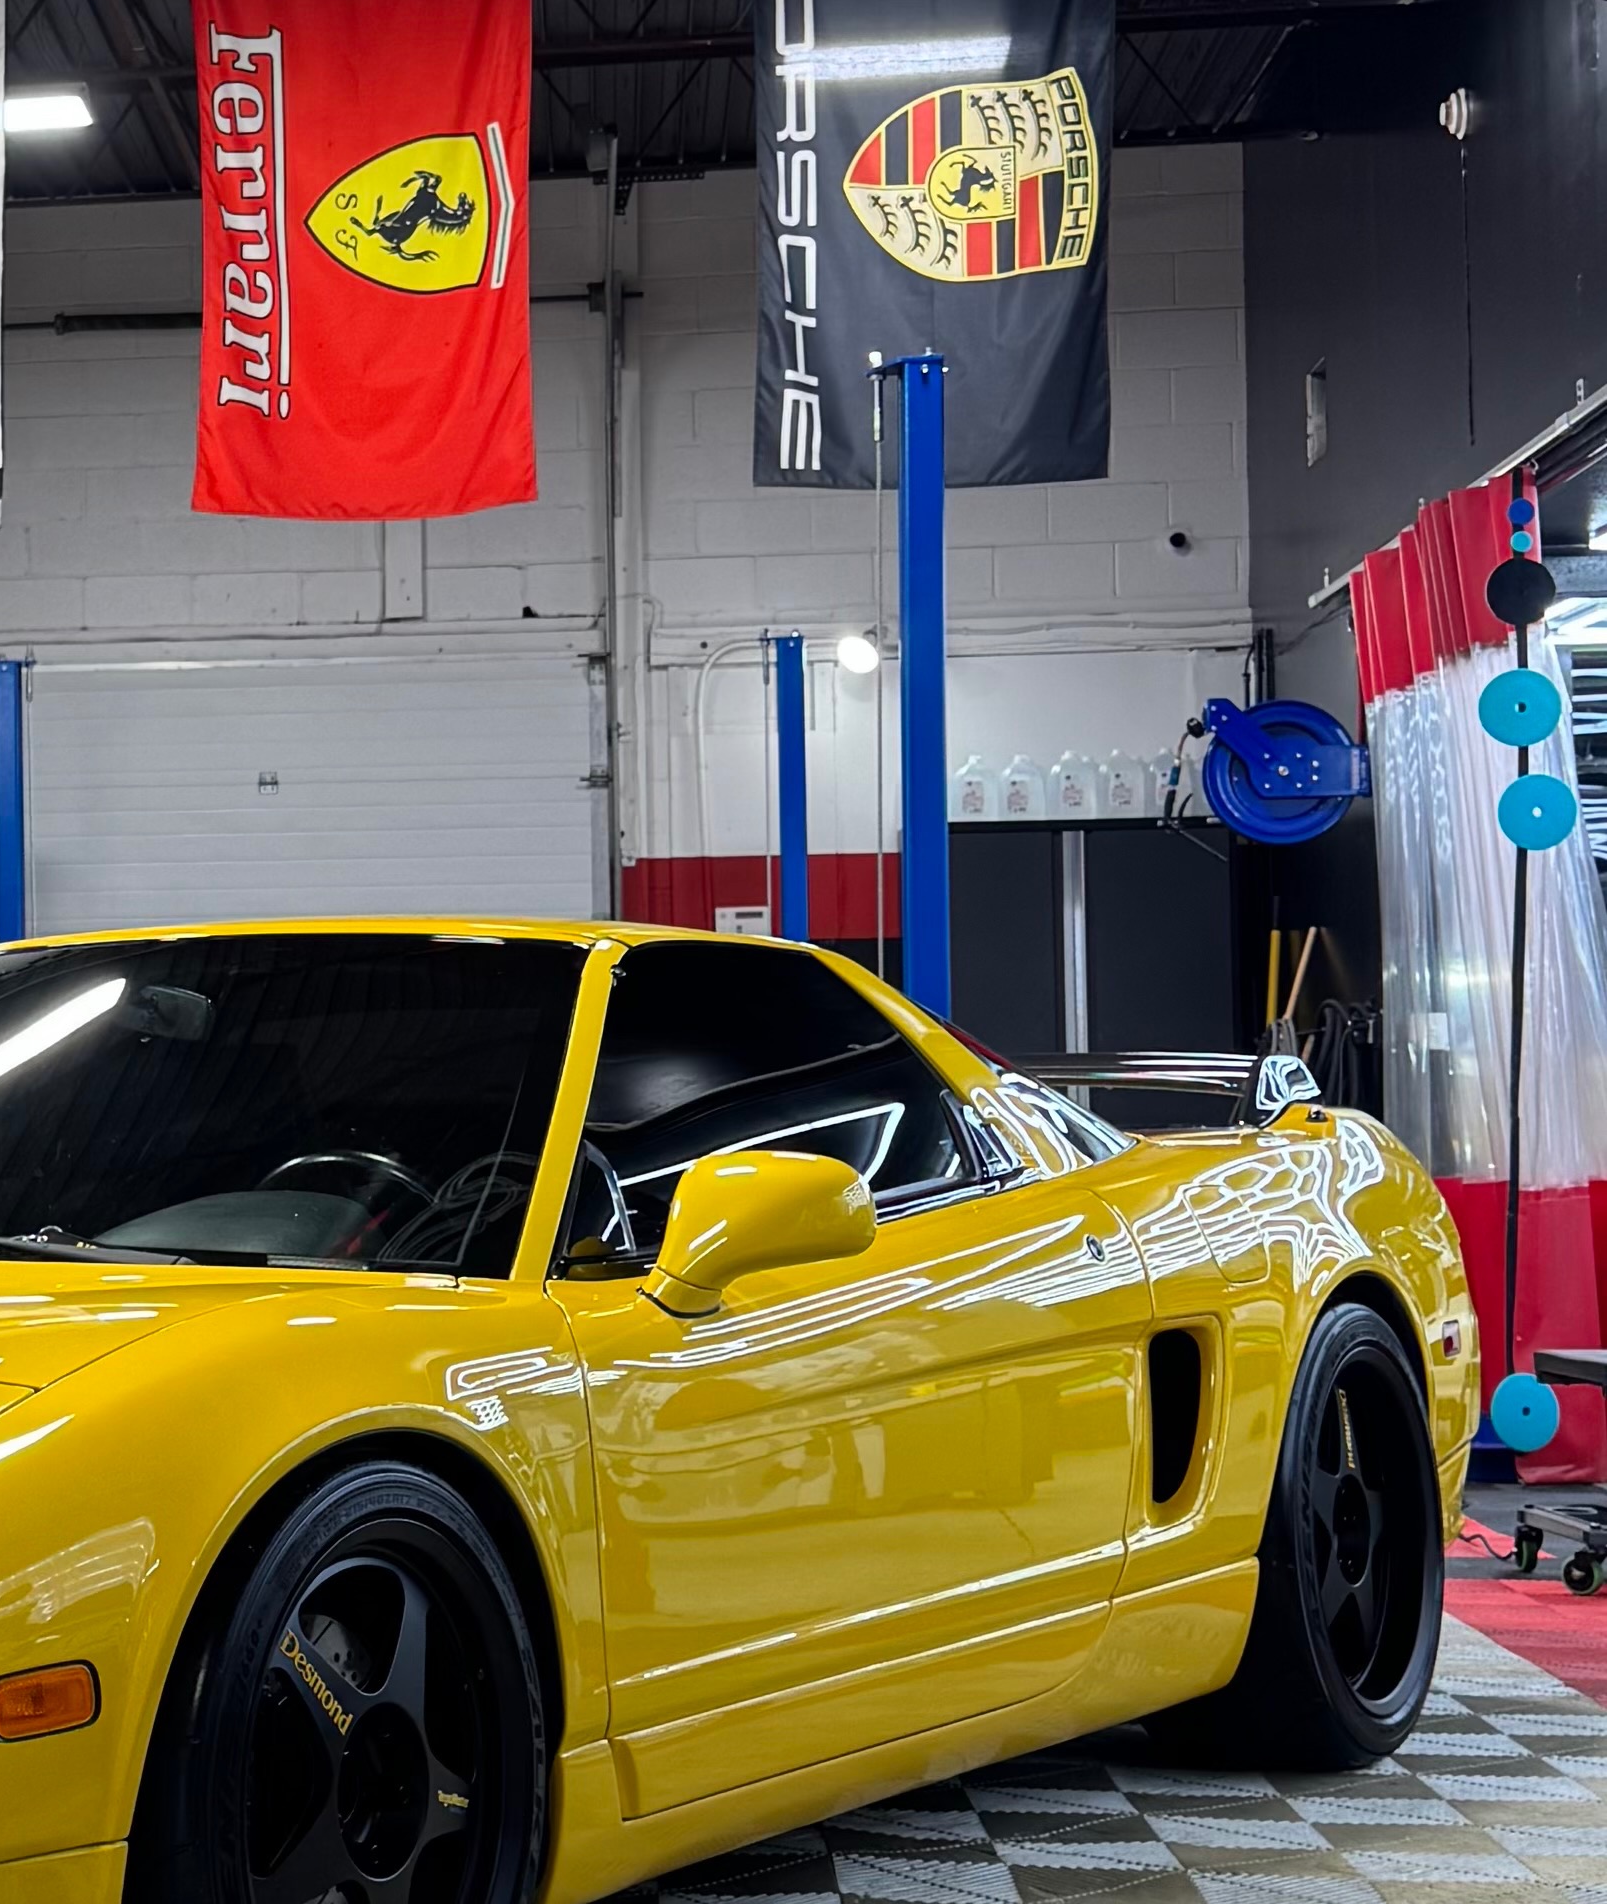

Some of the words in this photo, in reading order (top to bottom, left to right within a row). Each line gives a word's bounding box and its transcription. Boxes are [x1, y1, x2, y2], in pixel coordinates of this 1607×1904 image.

[208, 20, 291, 421] Ferrari
[1050, 75, 1090, 261] PORSCHE
[279, 1628, 354, 1736] Desmond
